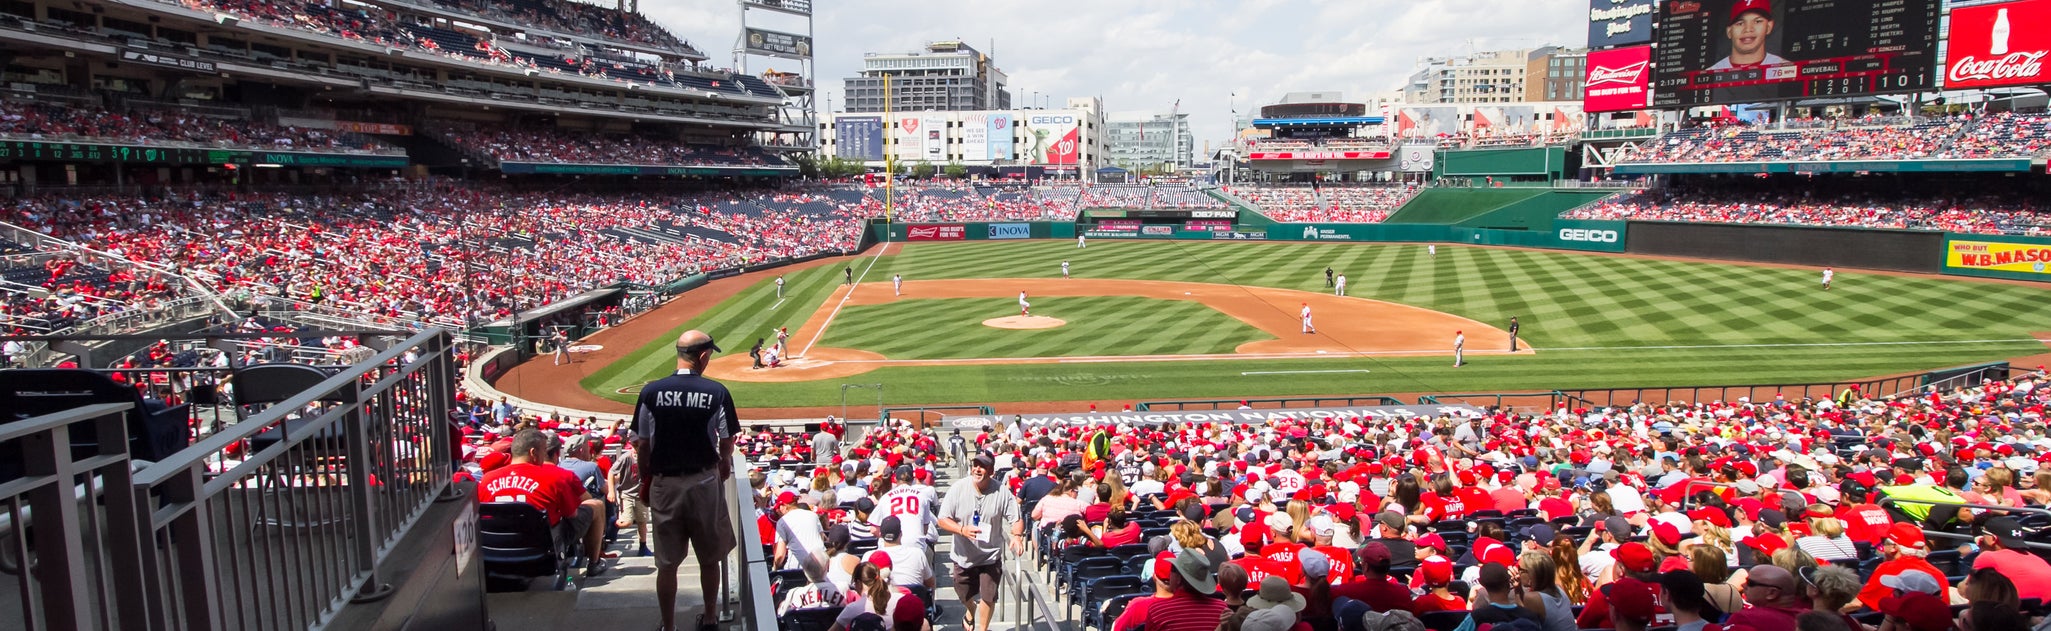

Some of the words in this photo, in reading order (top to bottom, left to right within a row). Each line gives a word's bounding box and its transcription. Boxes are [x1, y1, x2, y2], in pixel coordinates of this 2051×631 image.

[1590, 4, 1650, 22] Washington
[1606, 20, 1632, 38] Post
[180, 59, 195, 68] CLUB
[196, 62, 214, 70] LEVEL
[1802, 66, 1838, 74] CURVEBALL
[1950, 50, 2049, 82] Coca-Cola
[1590, 69, 1640, 81] Budweiser
[1882, 76, 1888, 88] 1
[1898, 74, 1908, 86] 0
[1918, 74, 1924, 86] 1
[1032, 116, 1072, 124] GEICO
[136, 150, 140, 160] 1
[162, 151, 164, 160] 1
[266, 154, 294, 164] INOVA
[1000, 226, 1029, 236] INOVA
[1560, 228, 1618, 242] GEICO
[656, 390, 682, 407] ASK
[686, 392, 713, 410] ME!
[1020, 412, 1234, 426] WASHINGTON
[1240, 408, 1416, 420] NATIONALS
[487, 476, 540, 496] SCHERZER
[1280, 476, 1298, 489] 26
[888, 488, 920, 498] MURPHY
[890, 496, 919, 516] 20
[458, 516, 474, 550] 126
[1330, 558, 1346, 574] PER
